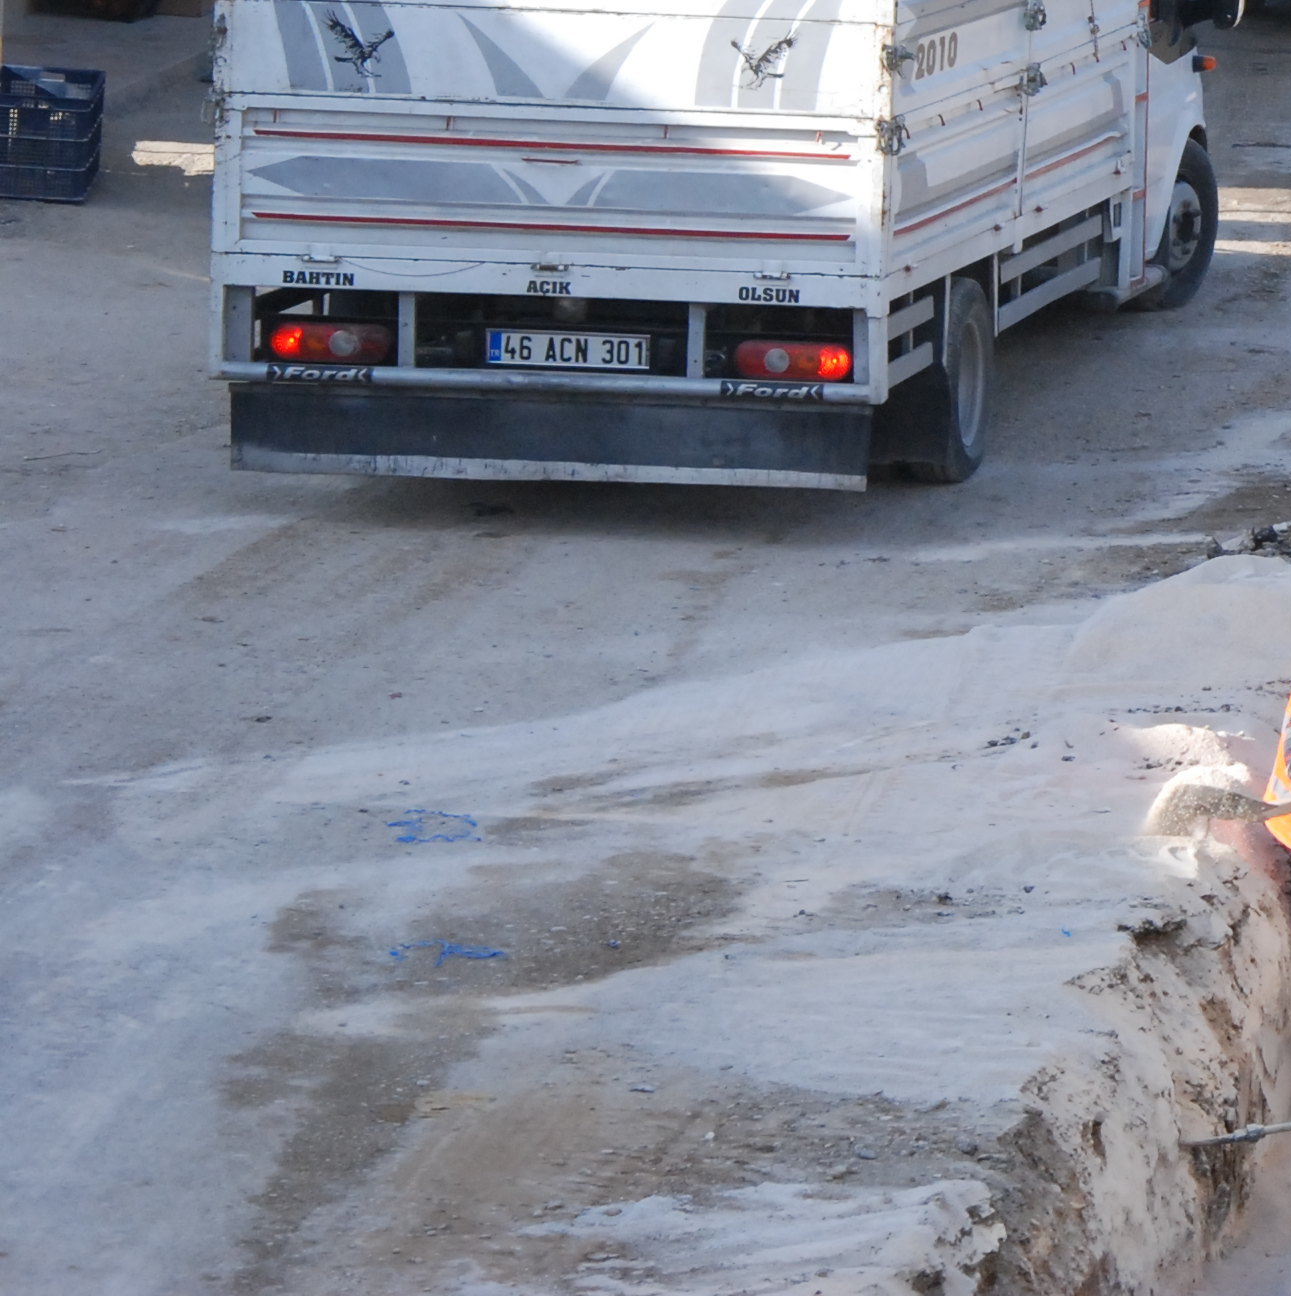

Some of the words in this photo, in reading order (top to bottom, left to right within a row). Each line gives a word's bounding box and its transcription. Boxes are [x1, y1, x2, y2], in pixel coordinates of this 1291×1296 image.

[915, 31, 958, 80] 2010
[283, 270, 354, 286] BAHTIN
[527, 280, 572, 296] AÇIK
[739, 286, 800, 304] OLSUN
[504, 335, 532, 361] 46
[545, 337, 589, 364] ACN
[601, 339, 644, 366] 301
[284, 366, 357, 381] Ford
[735, 383, 811, 399] Ford
